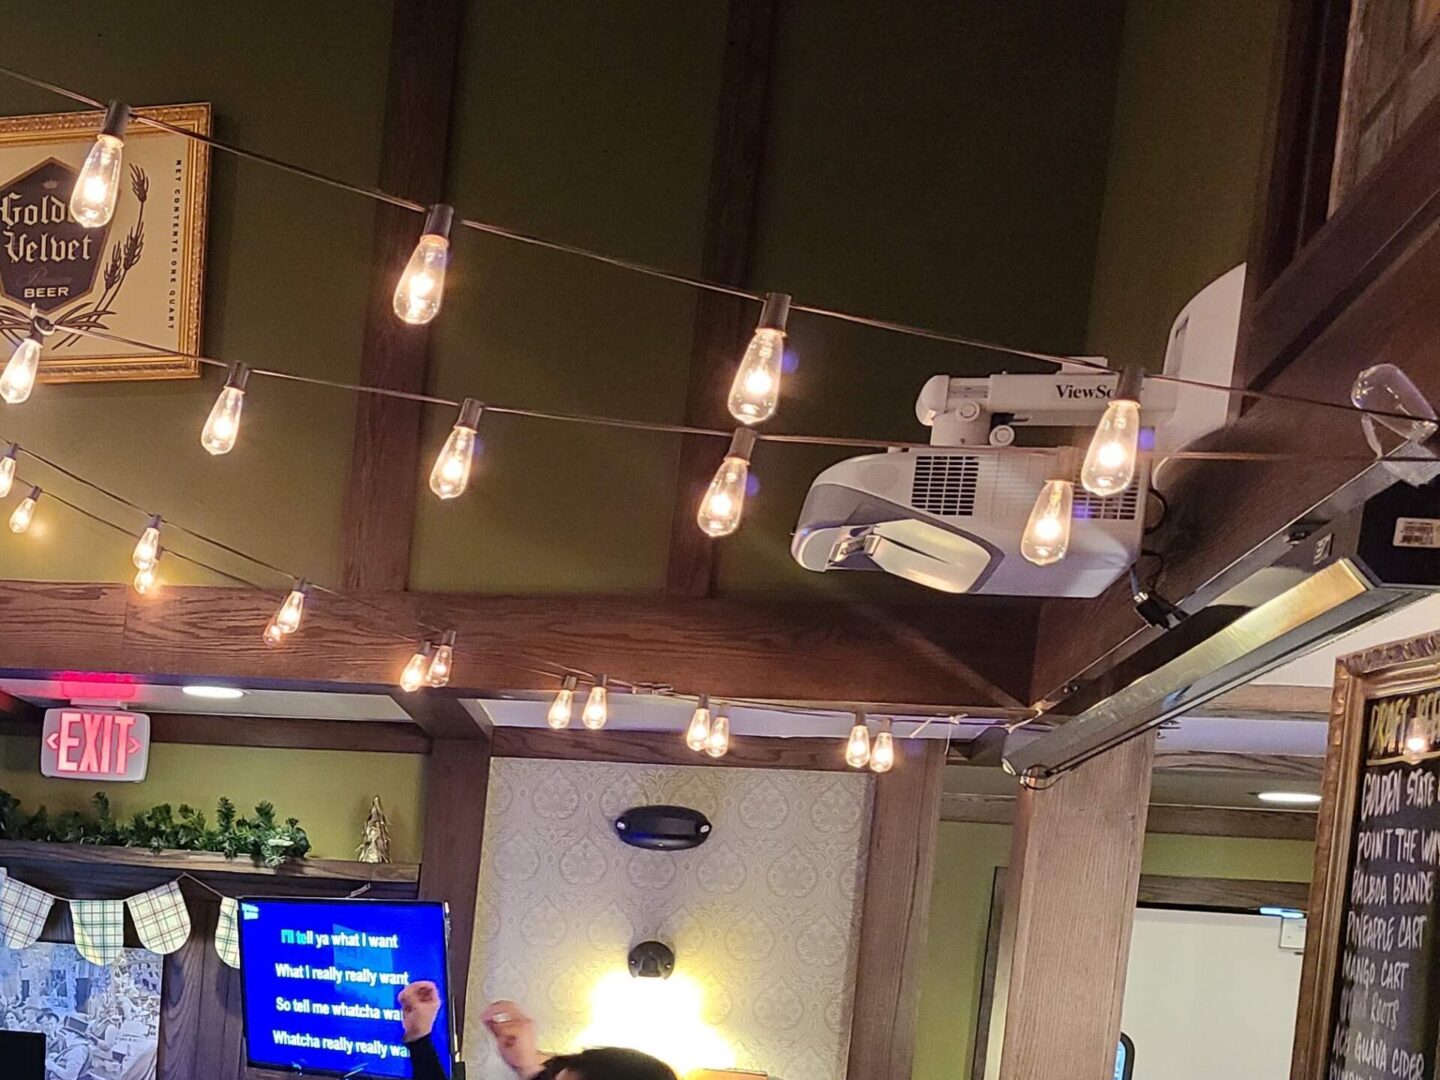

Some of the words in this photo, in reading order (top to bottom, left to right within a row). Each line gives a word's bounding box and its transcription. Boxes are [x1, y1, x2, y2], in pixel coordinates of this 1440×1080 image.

[171, 188, 181, 253] CONTENTS
[3, 230, 93, 263] Velvet
[24, 287, 69, 298] BEER
[168, 290, 176, 329] QUART
[57, 712, 136, 774] EXIT
[1361, 769, 1402, 822] GOLDEN
[1406, 768, 1435, 808] STATE
[1357, 829, 1393, 867] POINT
[1395, 828, 1419, 863] THE
[1351, 869, 1387, 907] BALBOA
[1393, 871, 1435, 904] BLONDE
[296, 930, 314, 945] tell
[316, 934, 330, 949] ya
[331, 932, 360, 947] what
[362, 932, 366, 947] I
[368, 934, 398, 949] want
[1346, 911, 1396, 952] PINEAPPLE
[1398, 915, 1427, 949] CART
[275, 963, 304, 979] What
[305, 965, 310, 979] I
[312, 966, 343, 984] really
[345, 968, 377, 987] really
[379, 971, 409, 986] want
[1342, 951, 1376, 990] MANGO
[1380, 960, 1409, 990] CART
[276, 997, 291, 1011] So
[293, 999, 310, 1014] tell
[312, 1003, 330, 1015] me
[331, 1002, 380, 1019] whatcha
[383, 1008, 404, 1021] wa
[273, 1029, 320, 1048] Whatcha
[322, 1036, 353, 1055] really
[355, 1040, 388, 1059] really
[390, 1045, 410, 1058] wa
[1355, 1032, 1387, 1072] GUAVA
